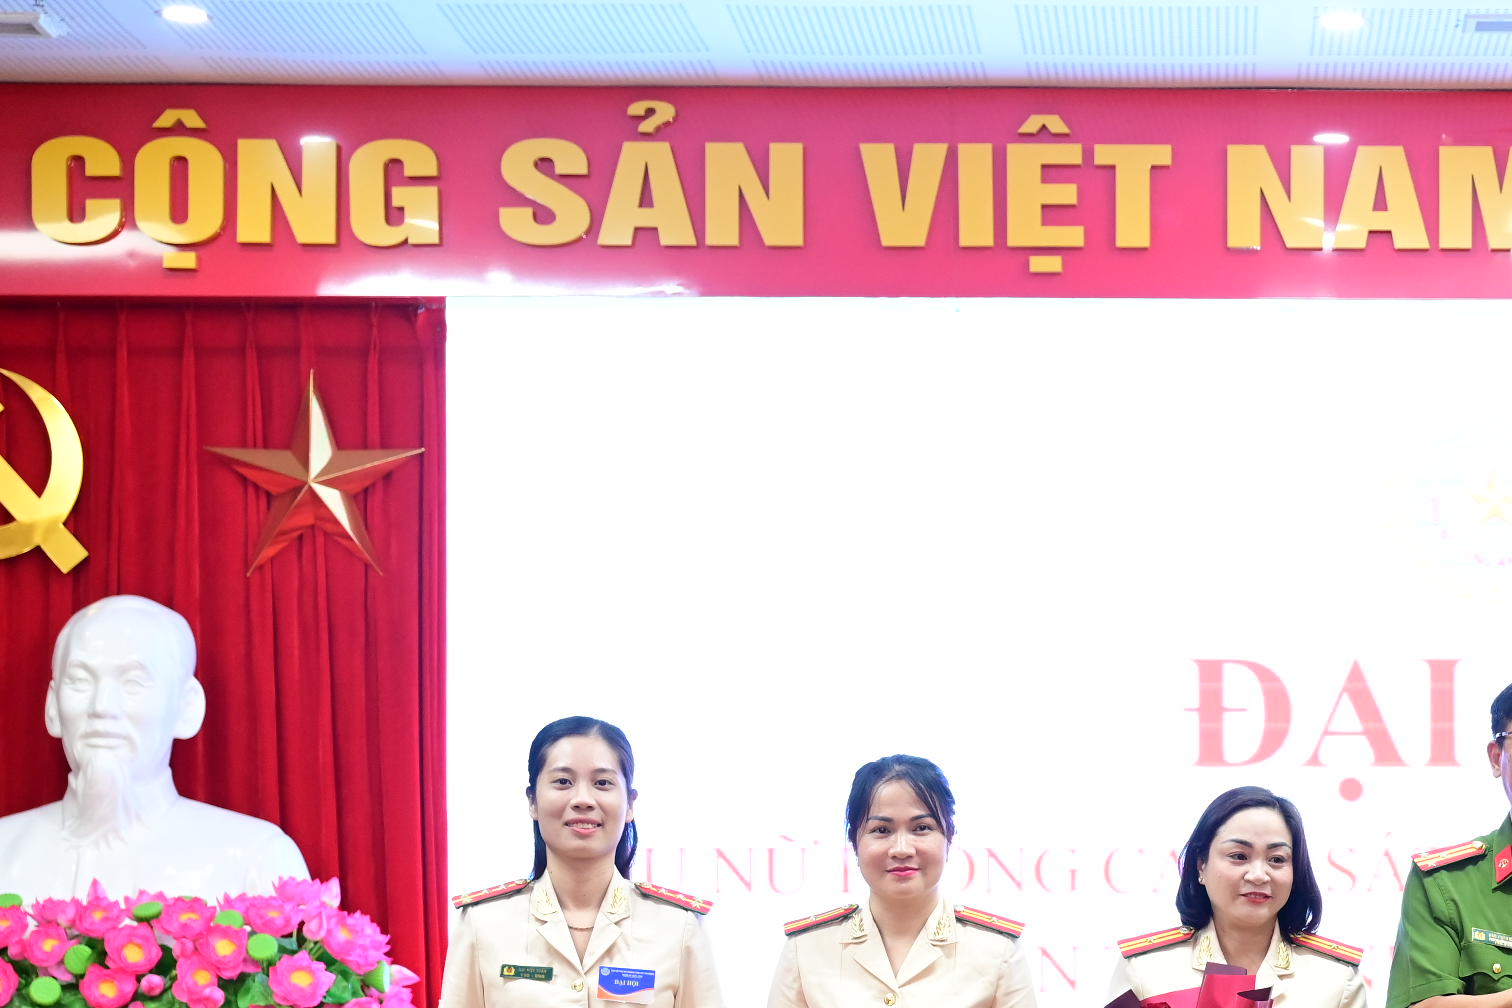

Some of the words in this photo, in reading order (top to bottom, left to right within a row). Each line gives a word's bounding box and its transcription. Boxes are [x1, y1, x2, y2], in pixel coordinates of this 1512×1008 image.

[30, 108, 442, 269] CỘNG
[498, 100, 804, 248] SẢN
[859, 114, 1172, 273] VIỆT
[1184, 658, 1463, 802] ĐẠI
